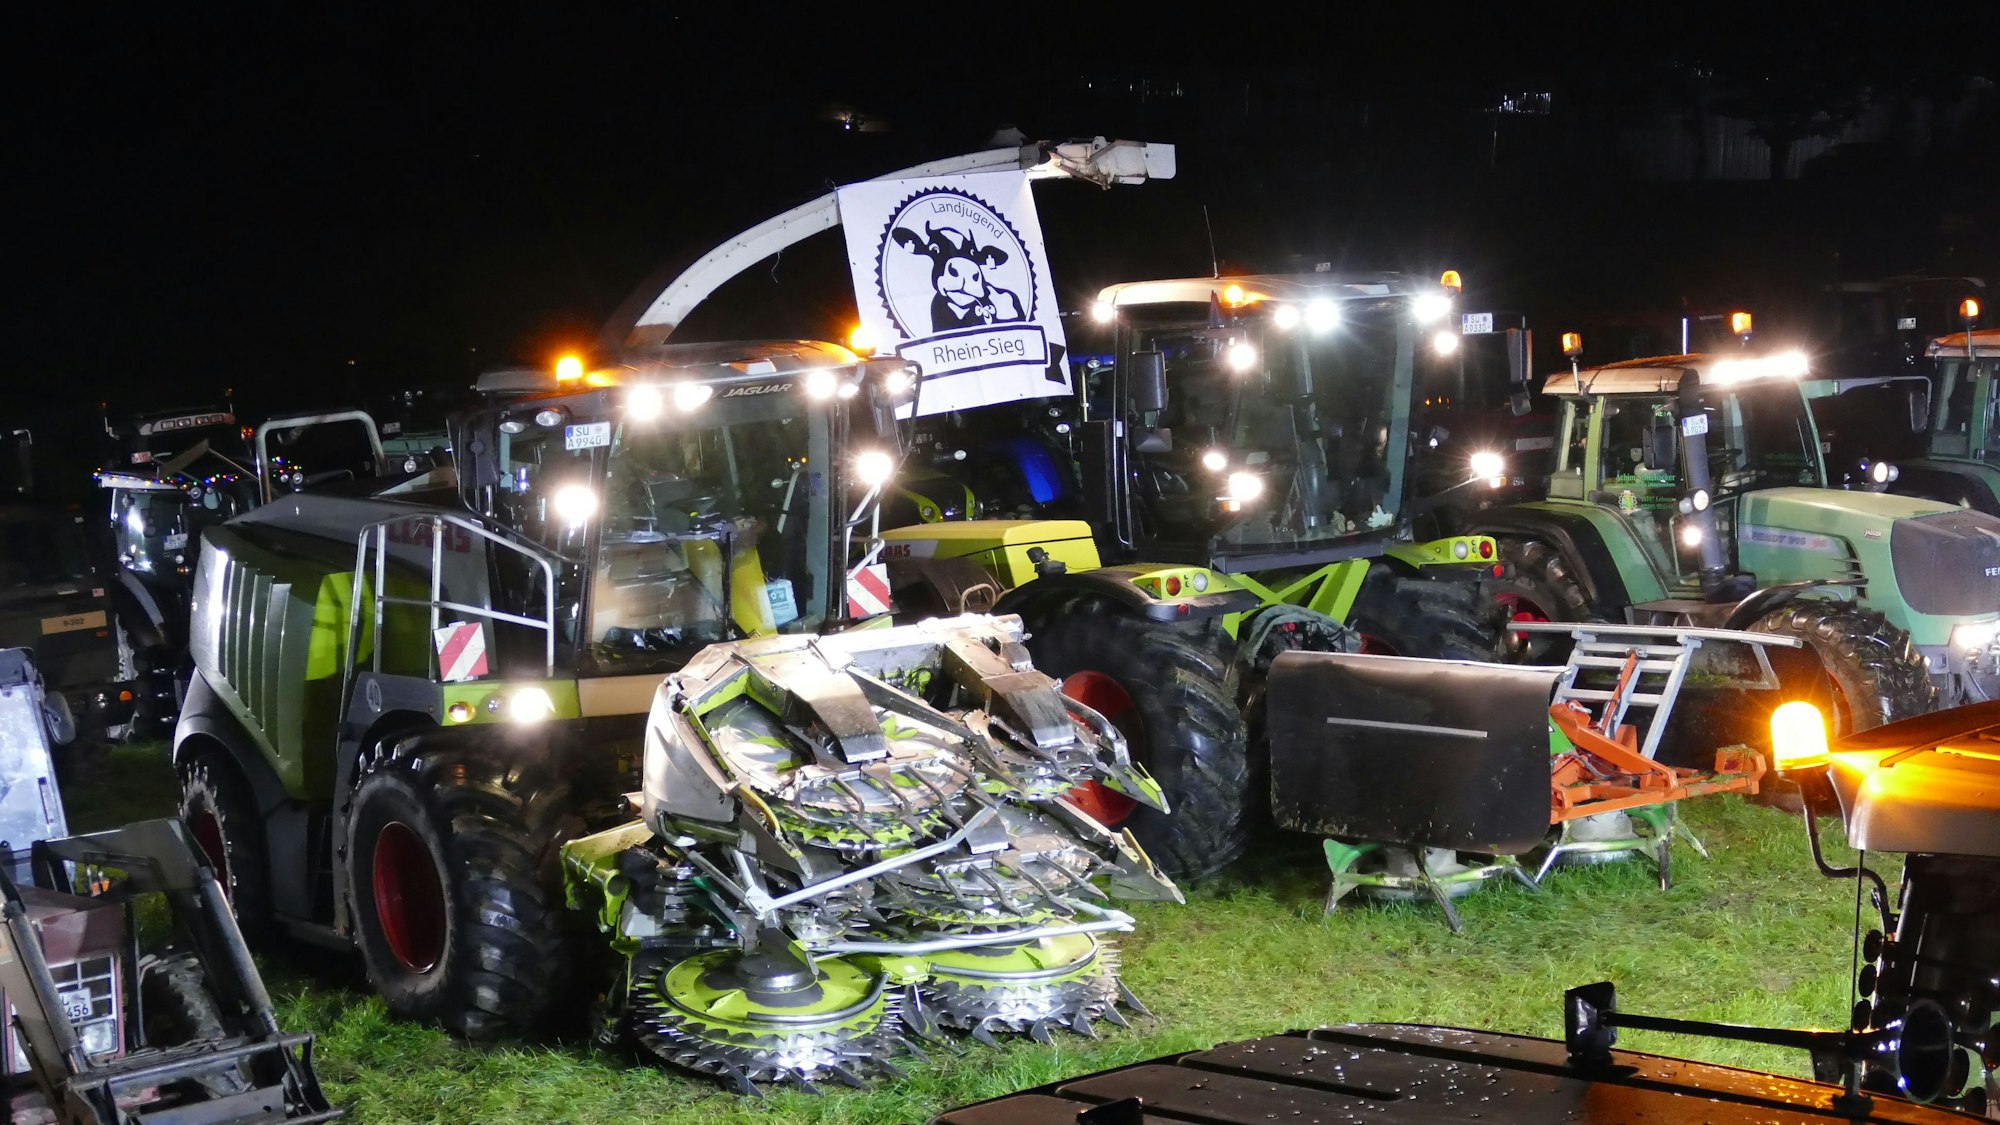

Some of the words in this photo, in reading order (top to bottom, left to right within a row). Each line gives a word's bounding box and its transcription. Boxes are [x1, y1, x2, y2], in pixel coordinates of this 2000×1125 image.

[930, 201, 1005, 240] Landjugend
[932, 338, 1026, 365] Rhein-Sieg
[723, 383, 793, 398] JAGUAR
[575, 426, 590, 437] SU
